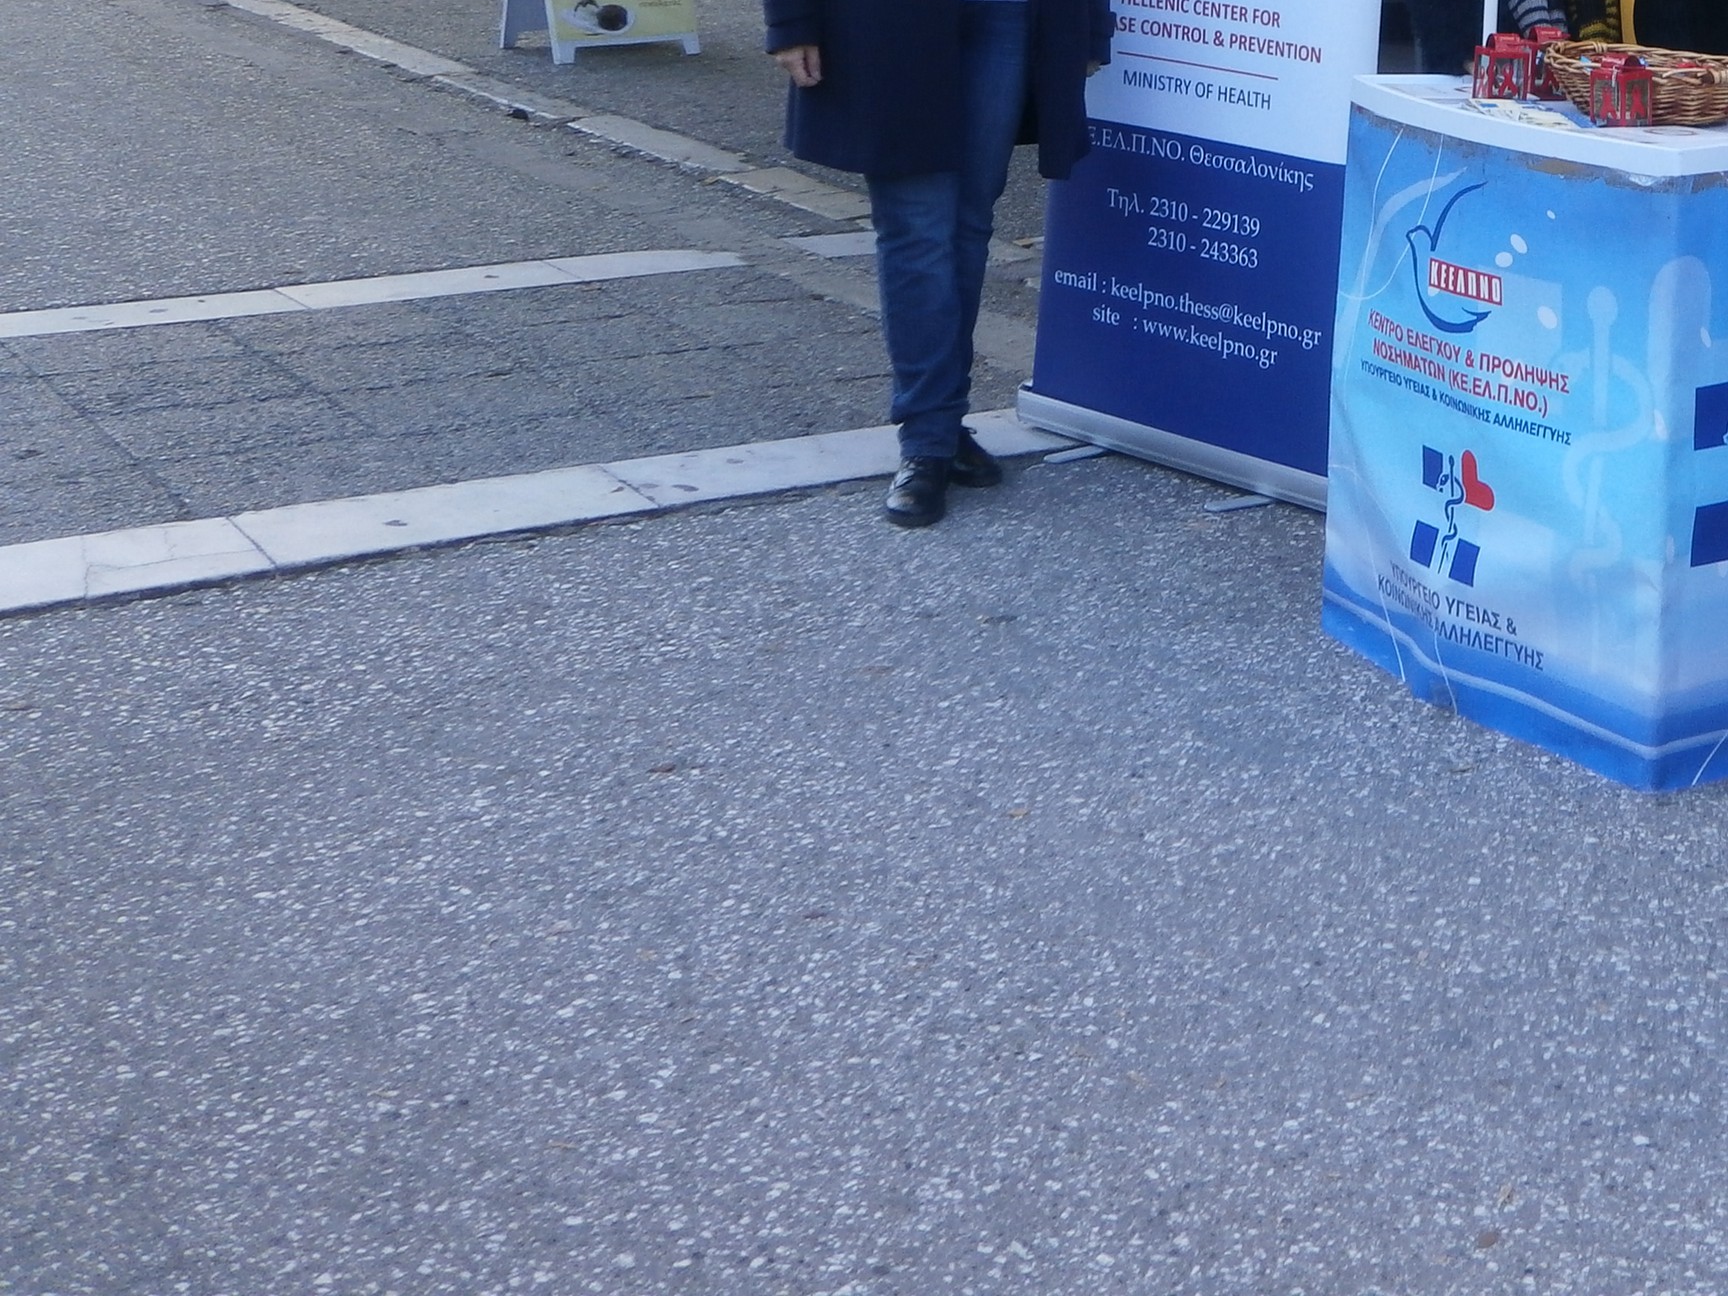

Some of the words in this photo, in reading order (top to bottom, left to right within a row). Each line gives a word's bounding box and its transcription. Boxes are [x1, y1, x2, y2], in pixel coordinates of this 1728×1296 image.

[1193, 0, 1248, 23] CENTER
[1252, 8, 1281, 29] FOR
[1140, 19, 1209, 45] CONTROL
[1213, 30, 1225, 48] &
[1229, 32, 1322, 64] PREVENTION
[1123, 69, 1192, 96] MINISTRY
[1195, 81, 1213, 99] OF
[1217, 86, 1272, 111] HEALTH
[1189, 144, 1315, 193] Θεσσαλονίκης
[1107, 187, 1145, 217] Τηλ.
[1149, 196, 1189, 222] 2310
[1202, 206, 1261, 238] 229139
[1147, 226, 1187, 253] 2310
[1200, 238, 1258, 269] 243363
[1430, 260, 1501, 303] ΚΕΕΛΠΝΟ
[1055, 267, 1098, 292] email
[1110, 276, 1322, 350] keelpno.thess@keelpno.gr
[1092, 304, 1121, 327] site
[1143, 316, 1278, 370] www.keelpno.gr
[1368, 308, 1403, 342] ΚΕΝΤΡΟ
[1407, 331, 1462, 361] ΕΛΕΓΧΟΥ
[1465, 350, 1475, 368] &
[1479, 353, 1570, 394] ΠΡΟΛΗΨΗΣ
[1360, 359, 1402, 386] ΥΠΟΥΡΓΕΙΟ
[1403, 376, 1430, 398] ΥΓΕΙΑΣ
[1432, 389, 1438, 401] &
[1439, 390, 1492, 424] ΚΟΙΝΩΝΙΚΗΣ
[1493, 412, 1572, 446] ΑΛΛΗΛΕΓΓΥΗΣ
[1373, 338, 1445, 383] ΝΟΣΗΜΑΤΩΝ
[1449, 367, 1549, 418] (ΚΕ.ΕΛ.Π.ΝΟ.)
[1390, 559, 1441, 609] ΥΠΟΥΡΓΕΙΟ
[1445, 599, 1502, 630] ΥΓΕΙΑΣ
[1506, 616, 1518, 636] &
[1434, 620, 1545, 671] ΑΛΛΗΛΕΓΓΥΗΣ
